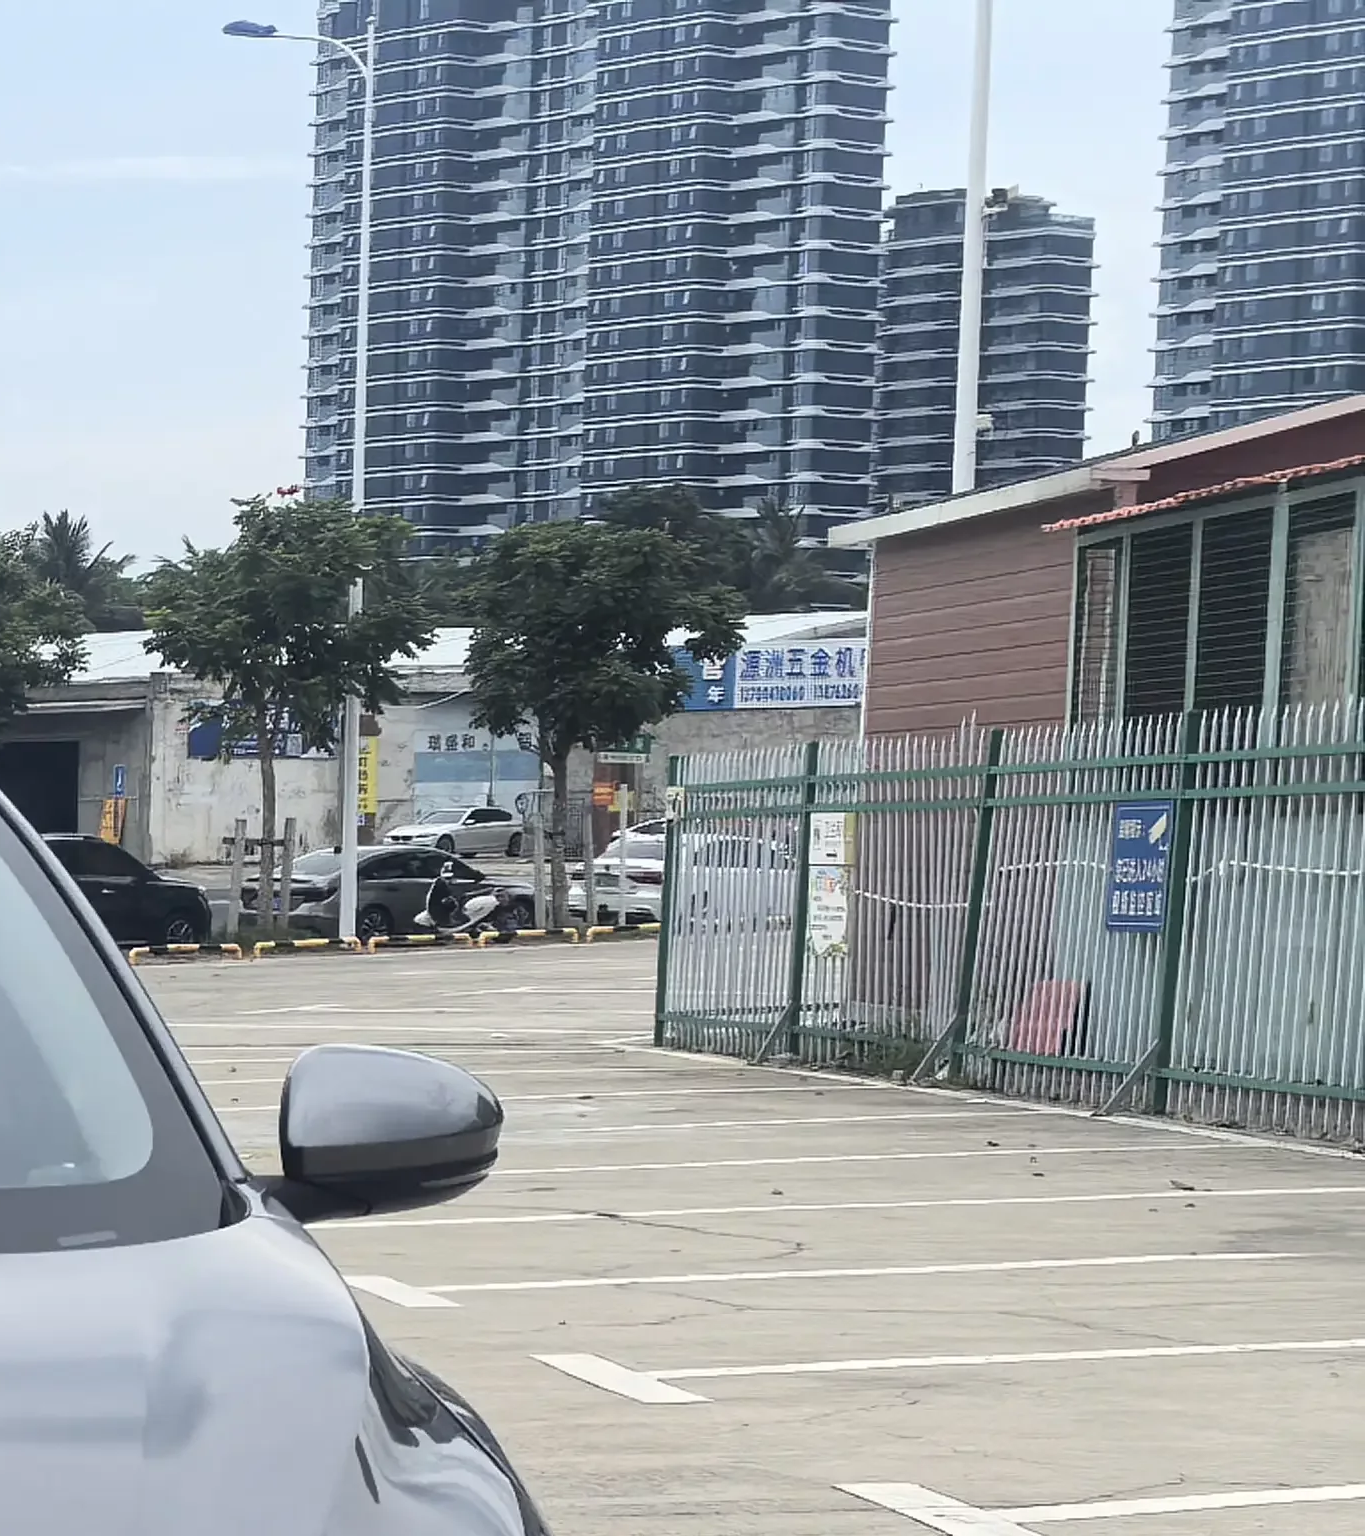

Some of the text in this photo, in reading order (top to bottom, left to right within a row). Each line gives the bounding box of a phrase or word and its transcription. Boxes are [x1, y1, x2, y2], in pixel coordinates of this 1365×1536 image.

[741, 647, 866, 680] 源洲五金机
